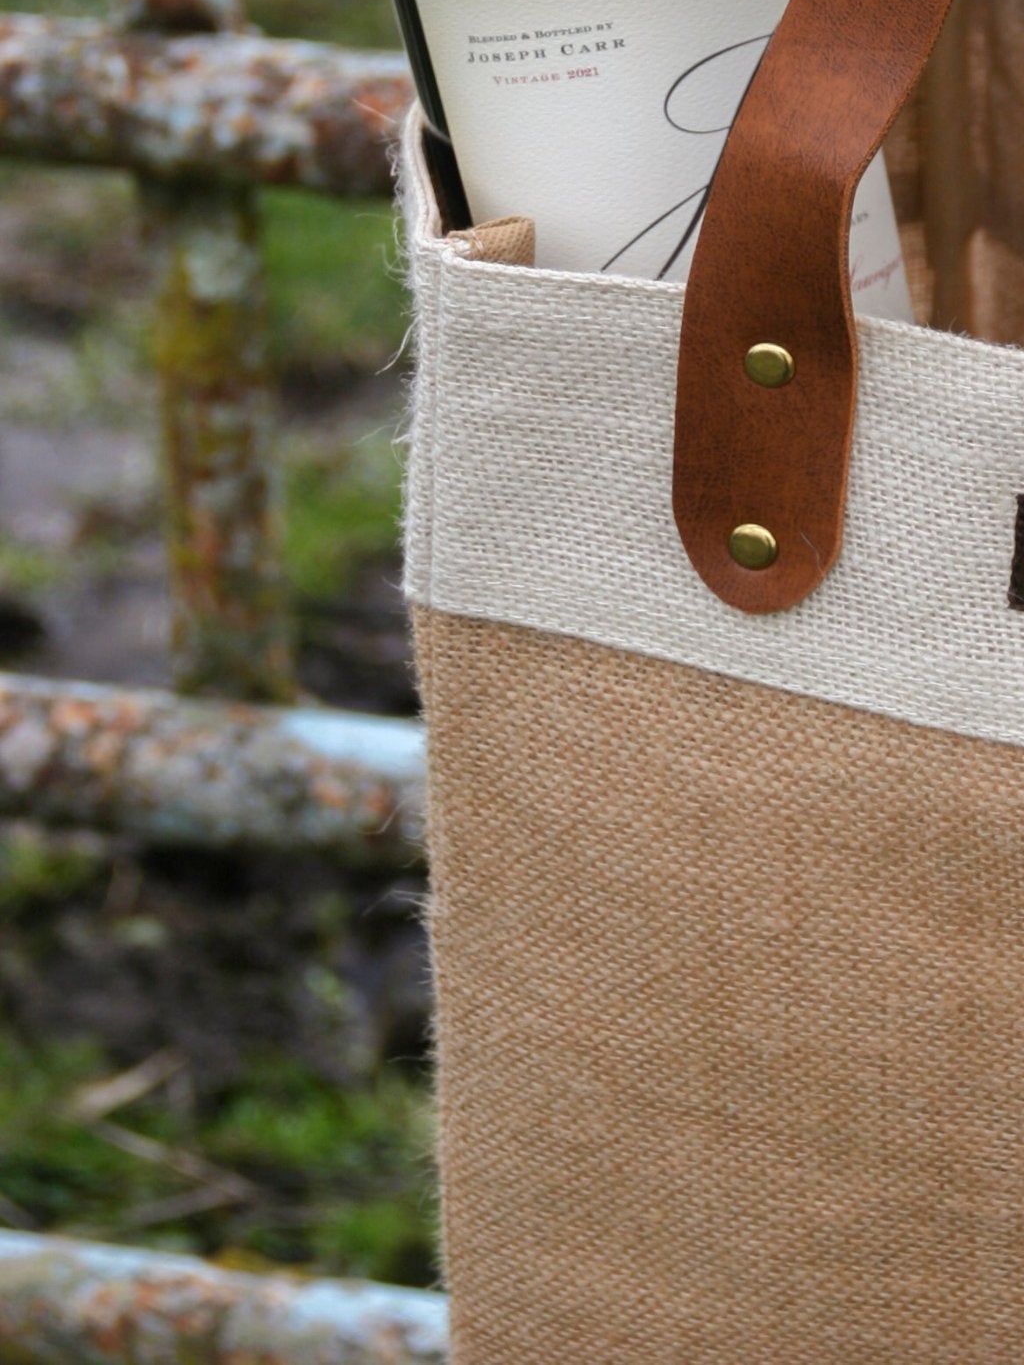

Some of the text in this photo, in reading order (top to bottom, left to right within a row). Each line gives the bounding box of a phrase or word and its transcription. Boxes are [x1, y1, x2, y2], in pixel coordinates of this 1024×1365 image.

[521, 32, 530, 40] &
[534, 26, 592, 39] BOTTLED
[596, 22, 614, 31] BY
[467, 38, 626, 63] JOSEPH CARR
[493, 66, 600, 85] VINTAGE 2021
